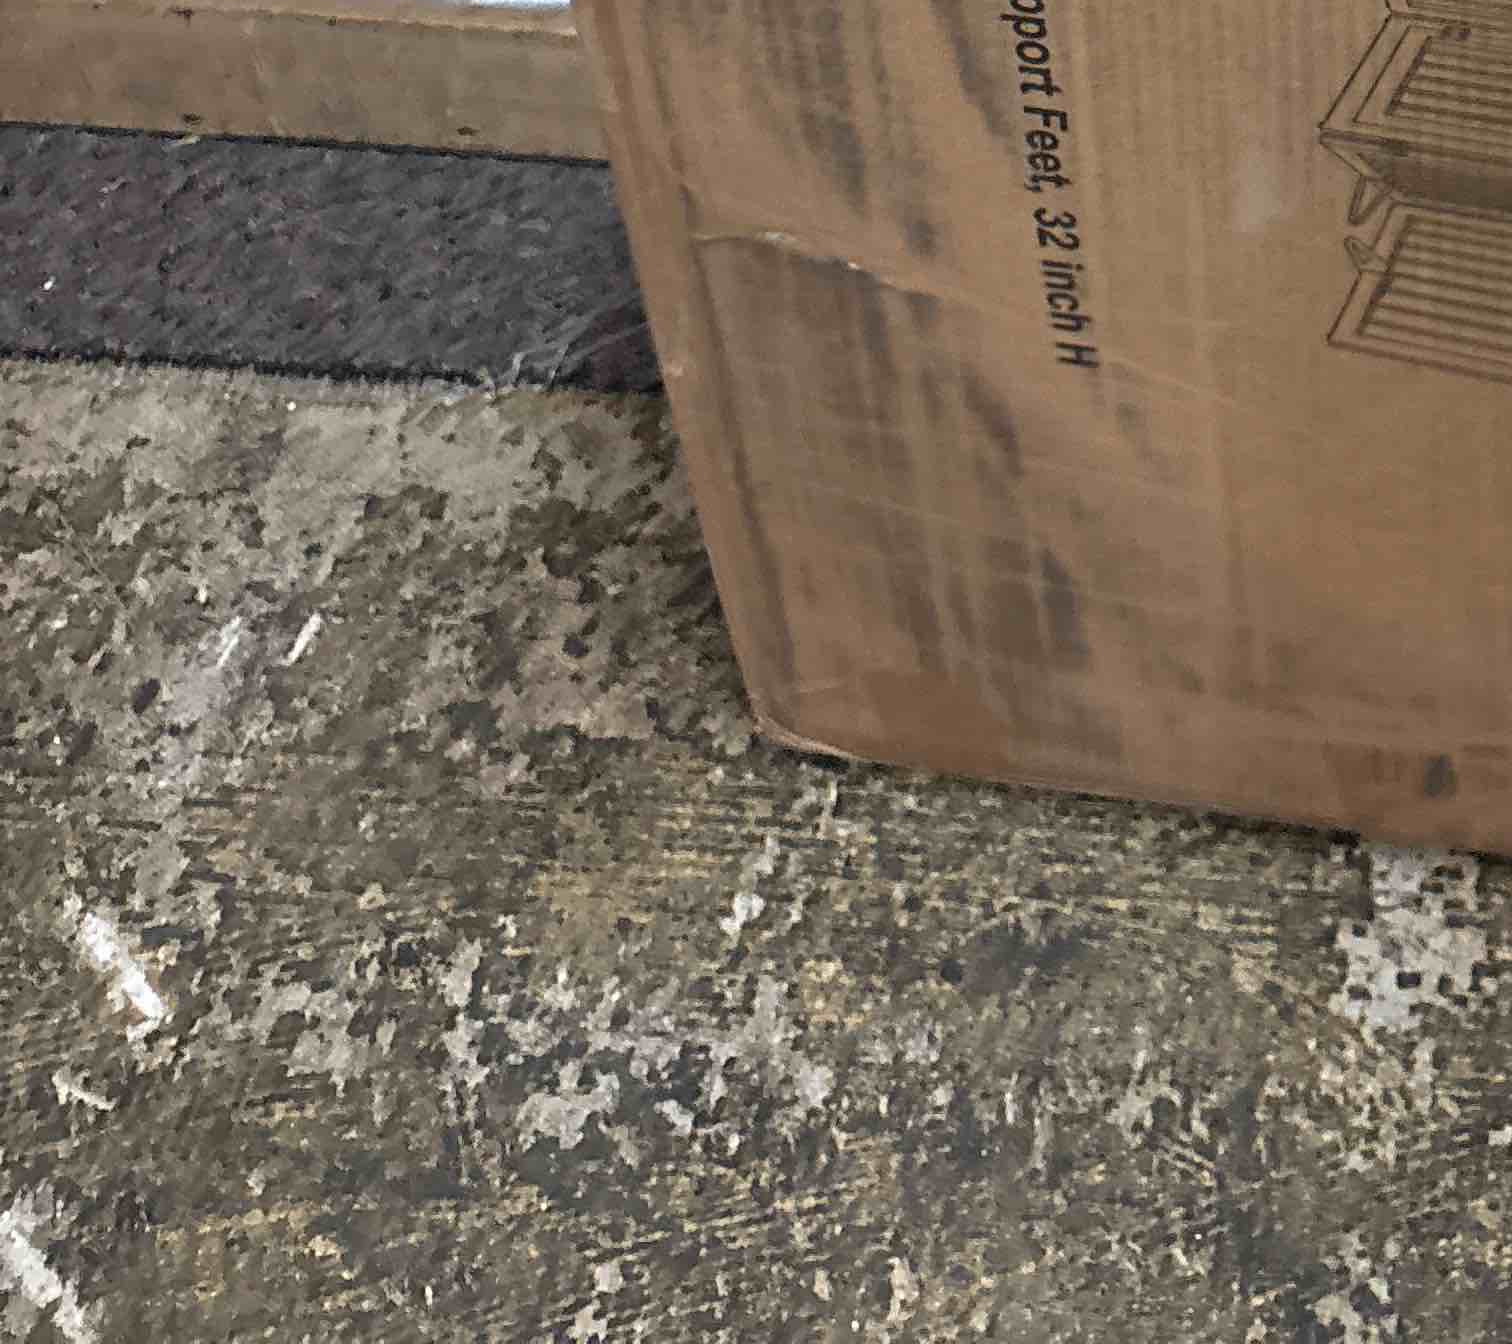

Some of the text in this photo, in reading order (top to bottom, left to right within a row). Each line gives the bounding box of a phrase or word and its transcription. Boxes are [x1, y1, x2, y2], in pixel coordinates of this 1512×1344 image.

[1024, 106, 1072, 192] Feet,
[1034, 208, 1079, 250] 32
[1043, 261, 1092, 332] inch
[1057, 343, 1098, 366] H
